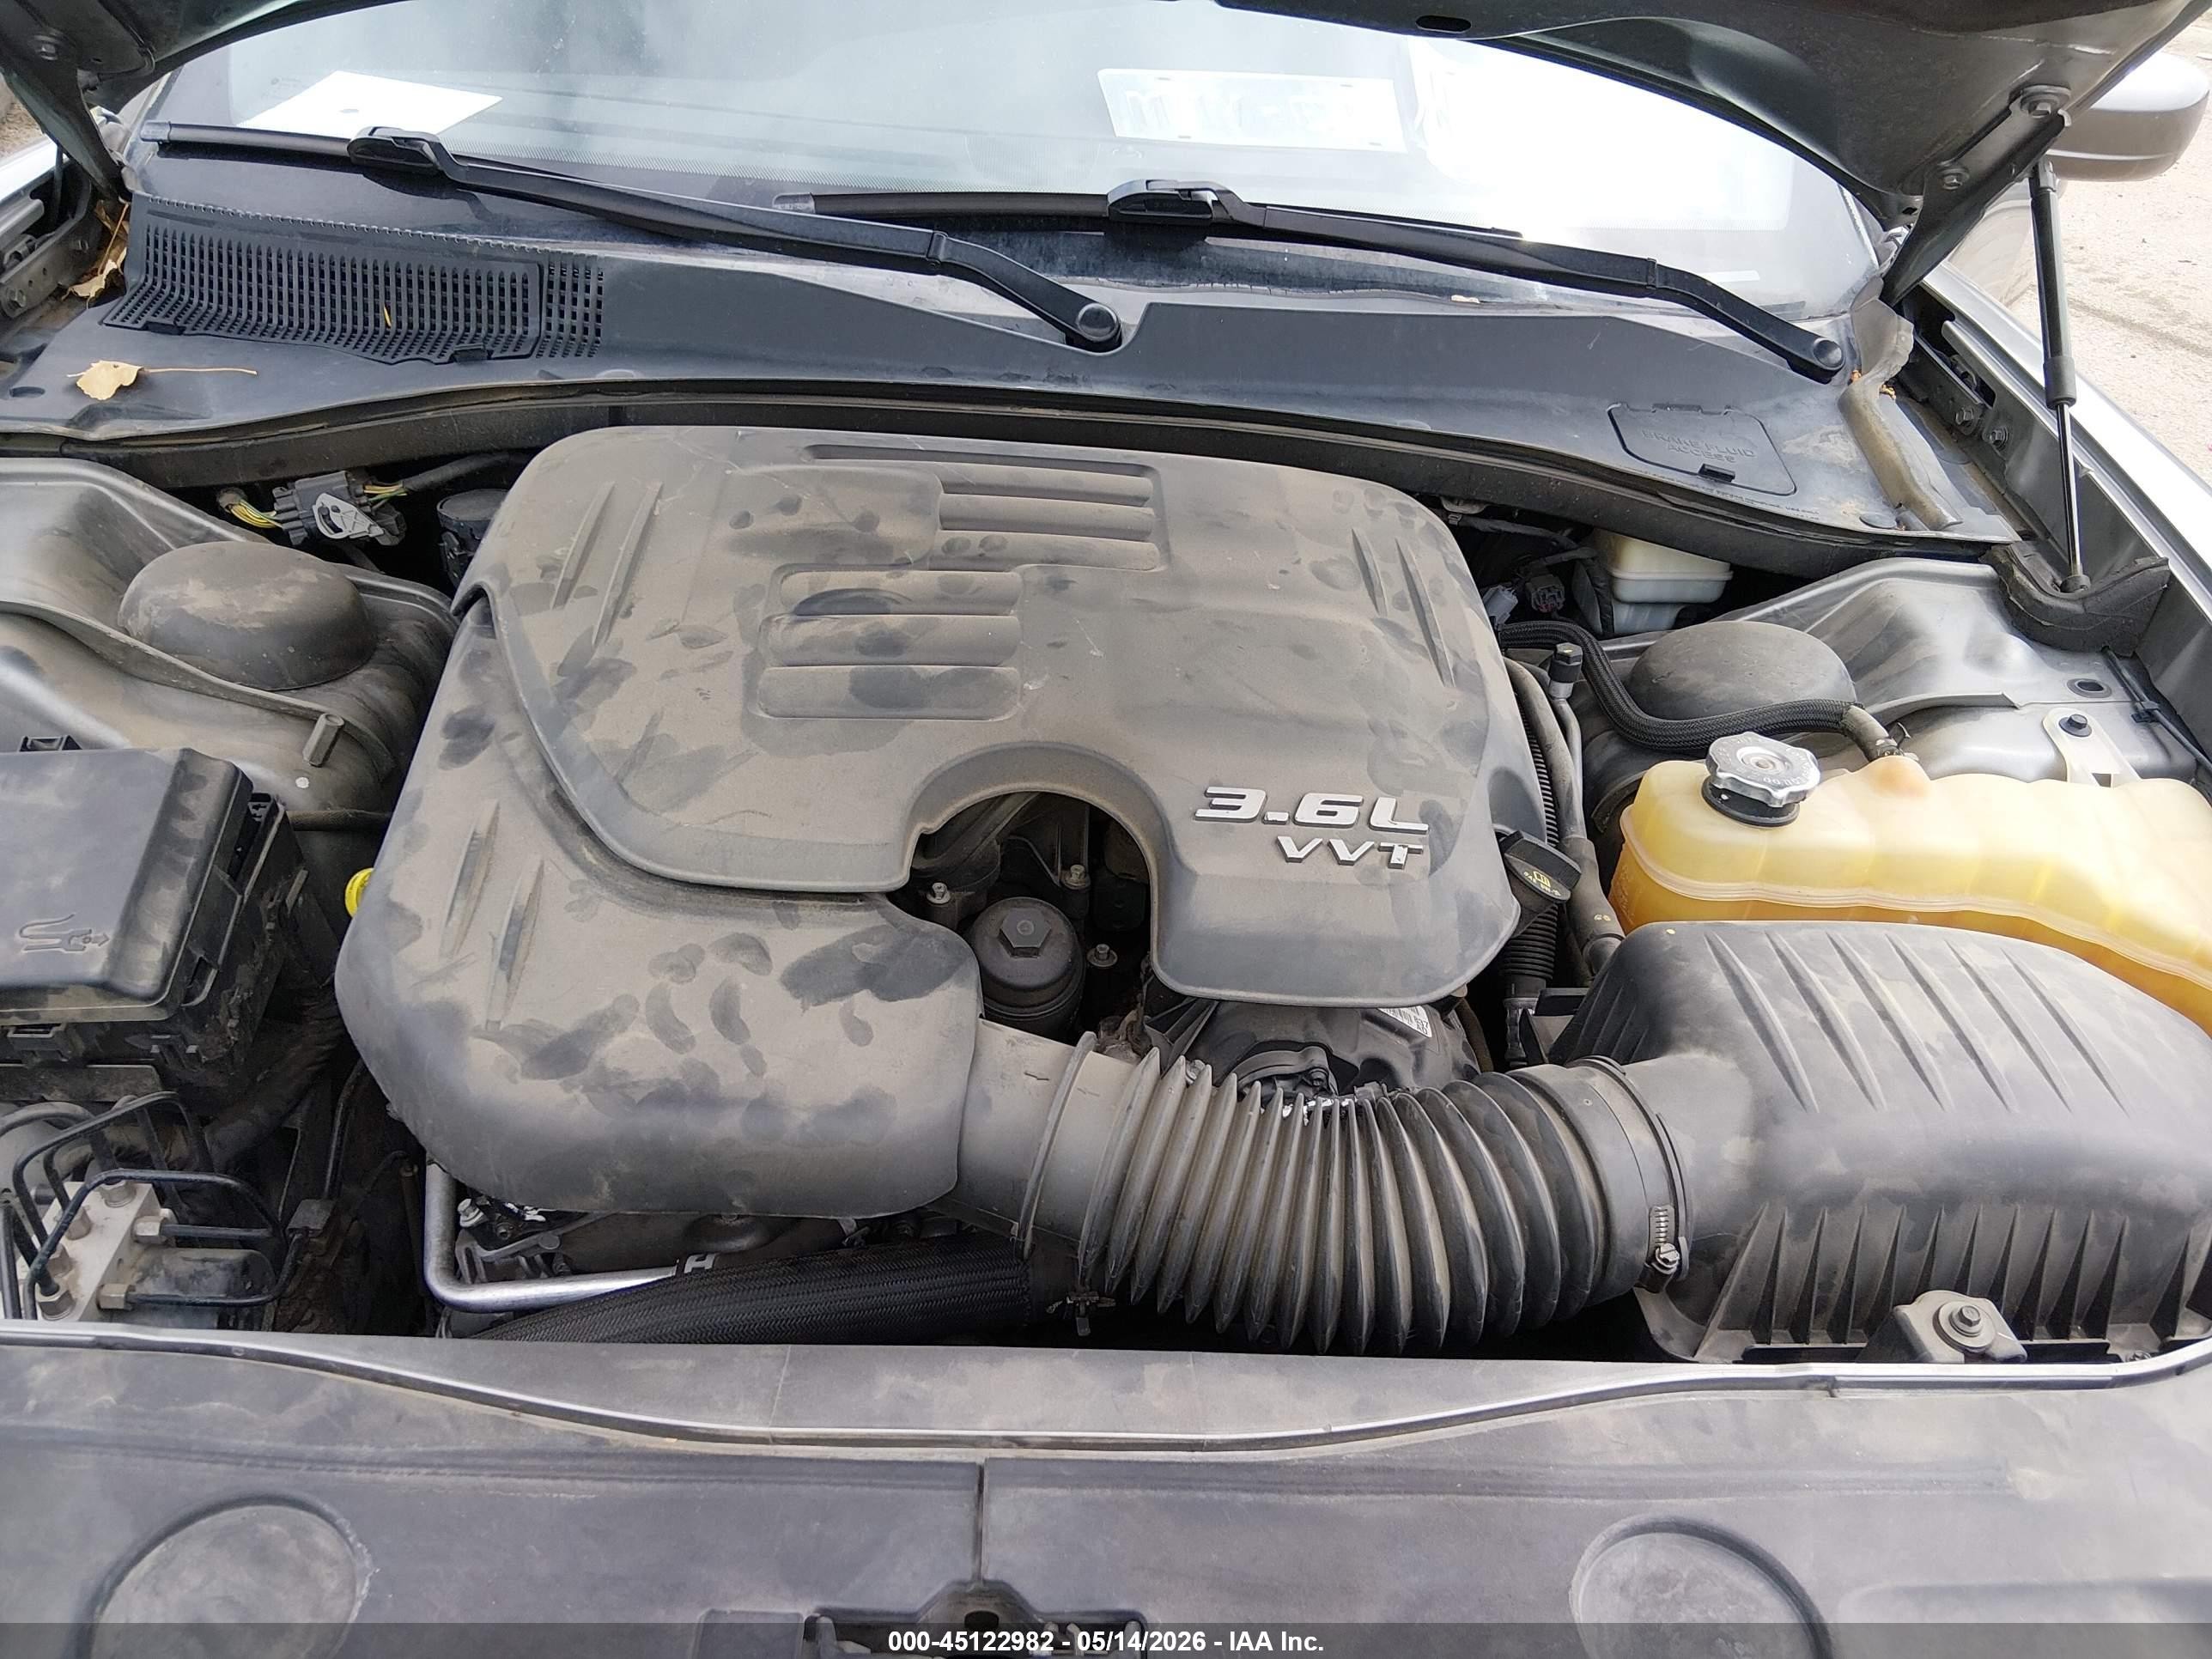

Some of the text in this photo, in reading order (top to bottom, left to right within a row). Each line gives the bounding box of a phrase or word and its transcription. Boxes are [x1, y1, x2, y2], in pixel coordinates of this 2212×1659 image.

[1643, 430, 1756, 458] BRAKE FLUID
[1668, 444, 1735, 463] ACCESS
[1194, 786, 1430, 835] 3.6L
[1276, 835, 1424, 869] VVT
